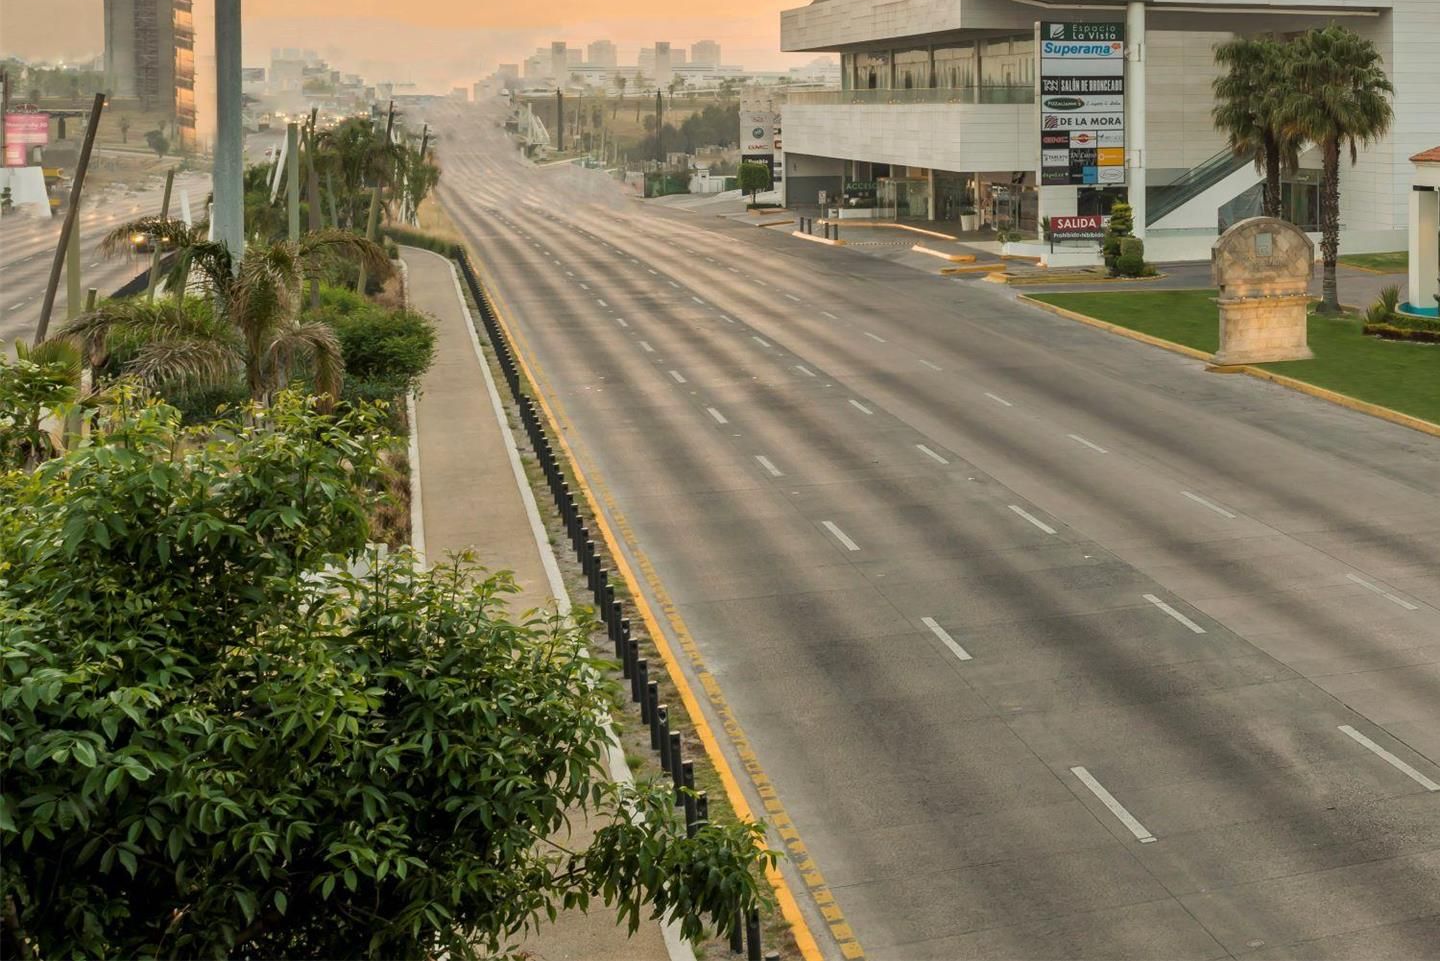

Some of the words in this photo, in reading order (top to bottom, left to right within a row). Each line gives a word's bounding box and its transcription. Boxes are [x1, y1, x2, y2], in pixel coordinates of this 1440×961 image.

[1072, 24, 1116, 33] Espacio
[1072, 32, 1085, 40] La
[1088, 32, 1116, 40] Vista
[1044, 41, 1111, 56] Superama
[1060, 117, 1073, 126] DE
[1075, 117, 1088, 126] LA
[1090, 117, 1122, 126] MORA
[1057, 218, 1097, 229] SALIDA
